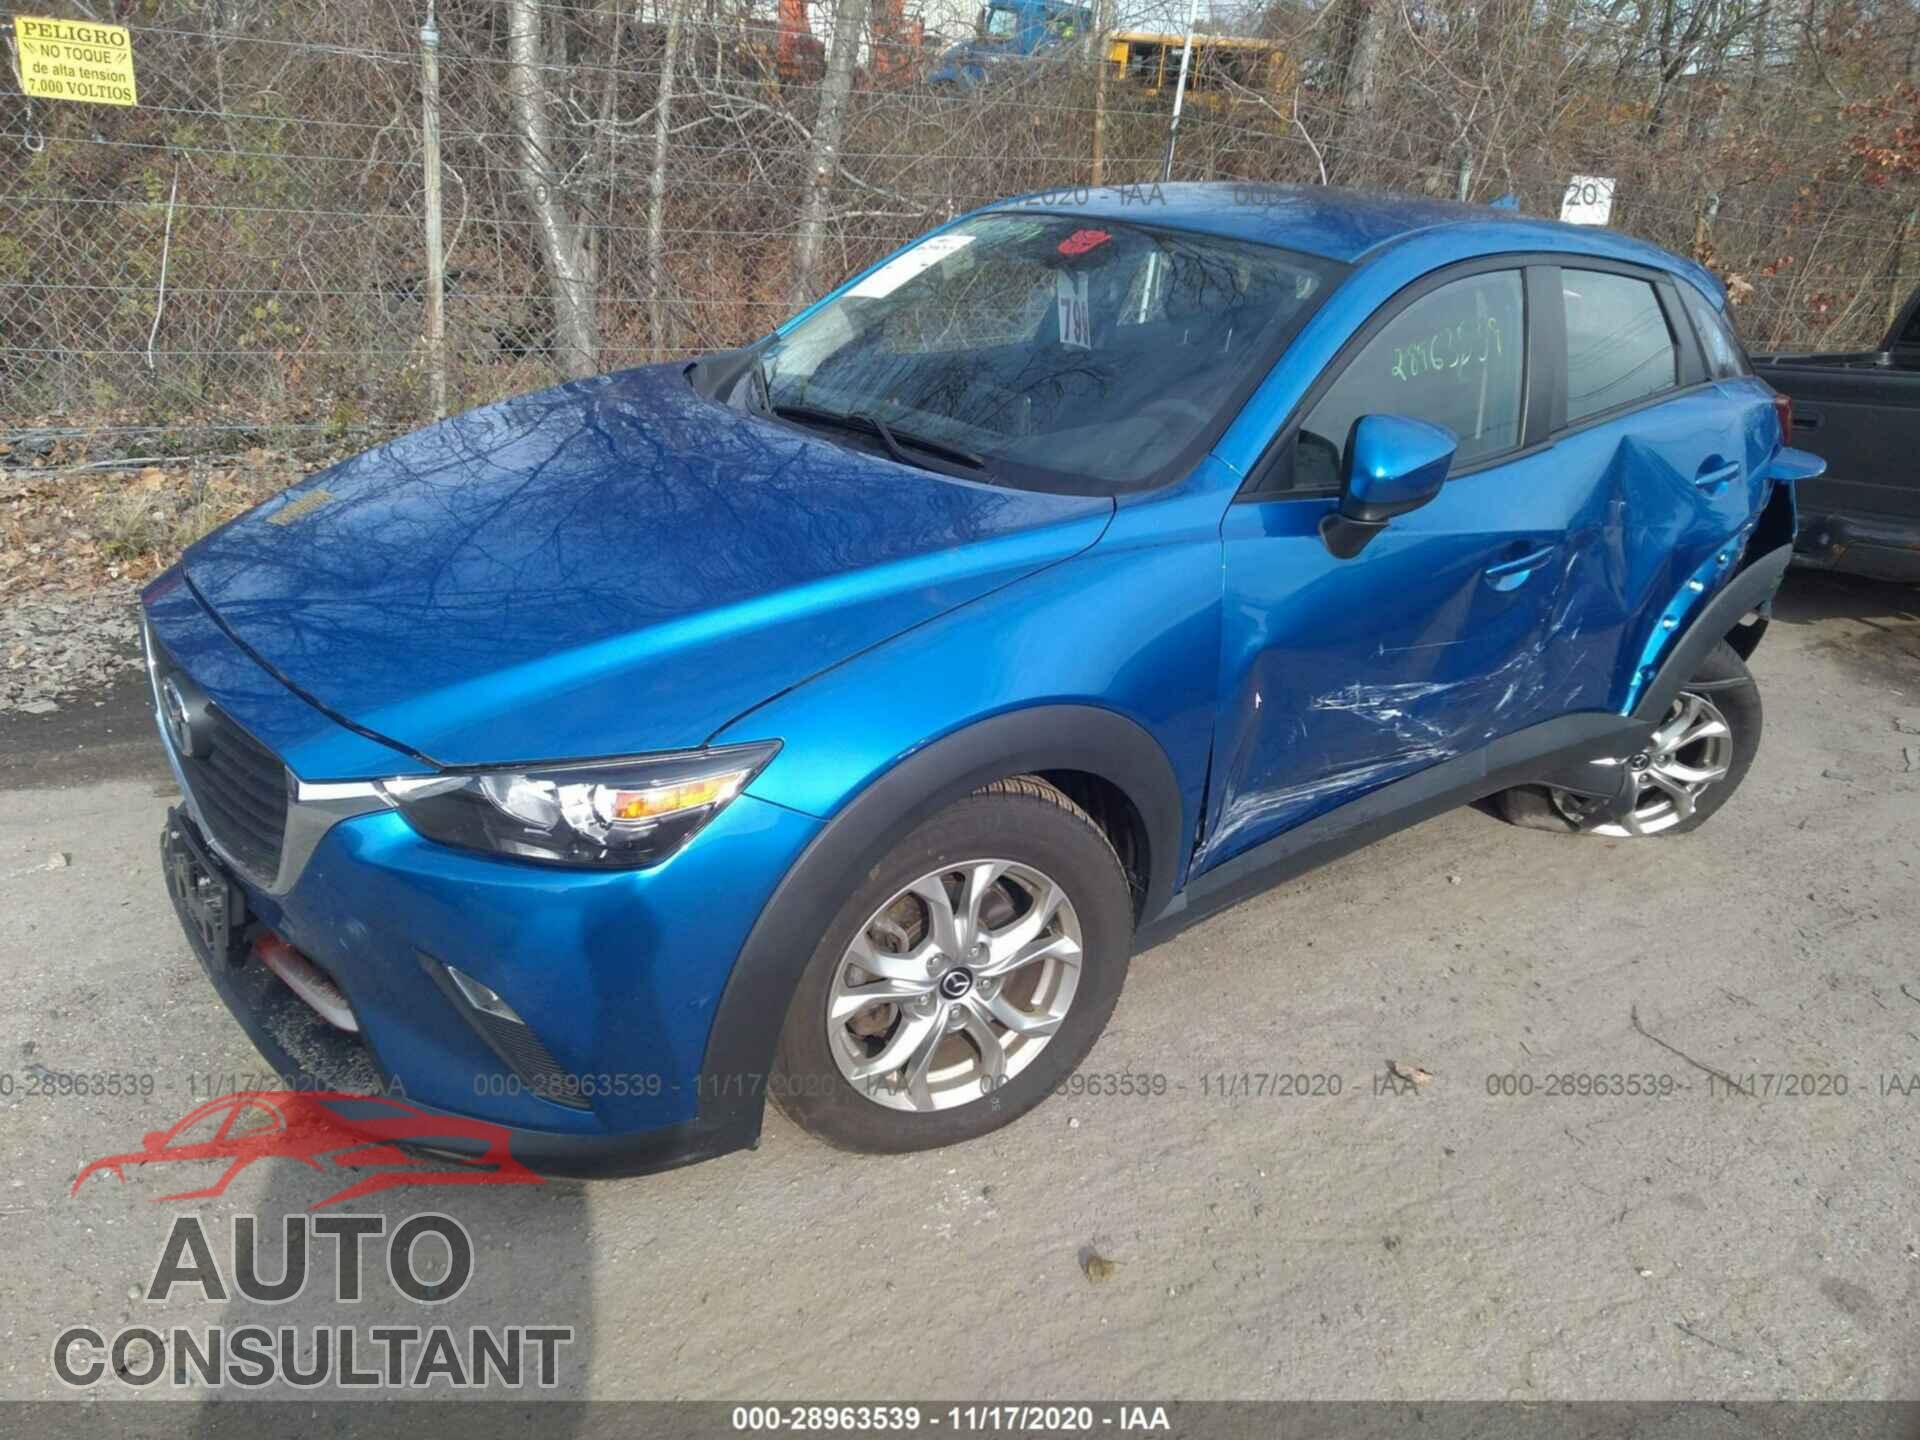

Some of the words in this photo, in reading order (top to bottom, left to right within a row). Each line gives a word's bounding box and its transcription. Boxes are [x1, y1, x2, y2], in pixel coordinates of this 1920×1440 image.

[23, 22, 125, 47] PELIGRO
[40, 44, 60, 58] NO
[66, 46, 112, 64] TOQUE
[33, 62, 48, 74] de
[52, 63, 75, 77] alta
[80, 68, 126, 83] tension
[66, 82, 132, 101] VOLTIOS
[1565, 183, 1597, 206] 20
